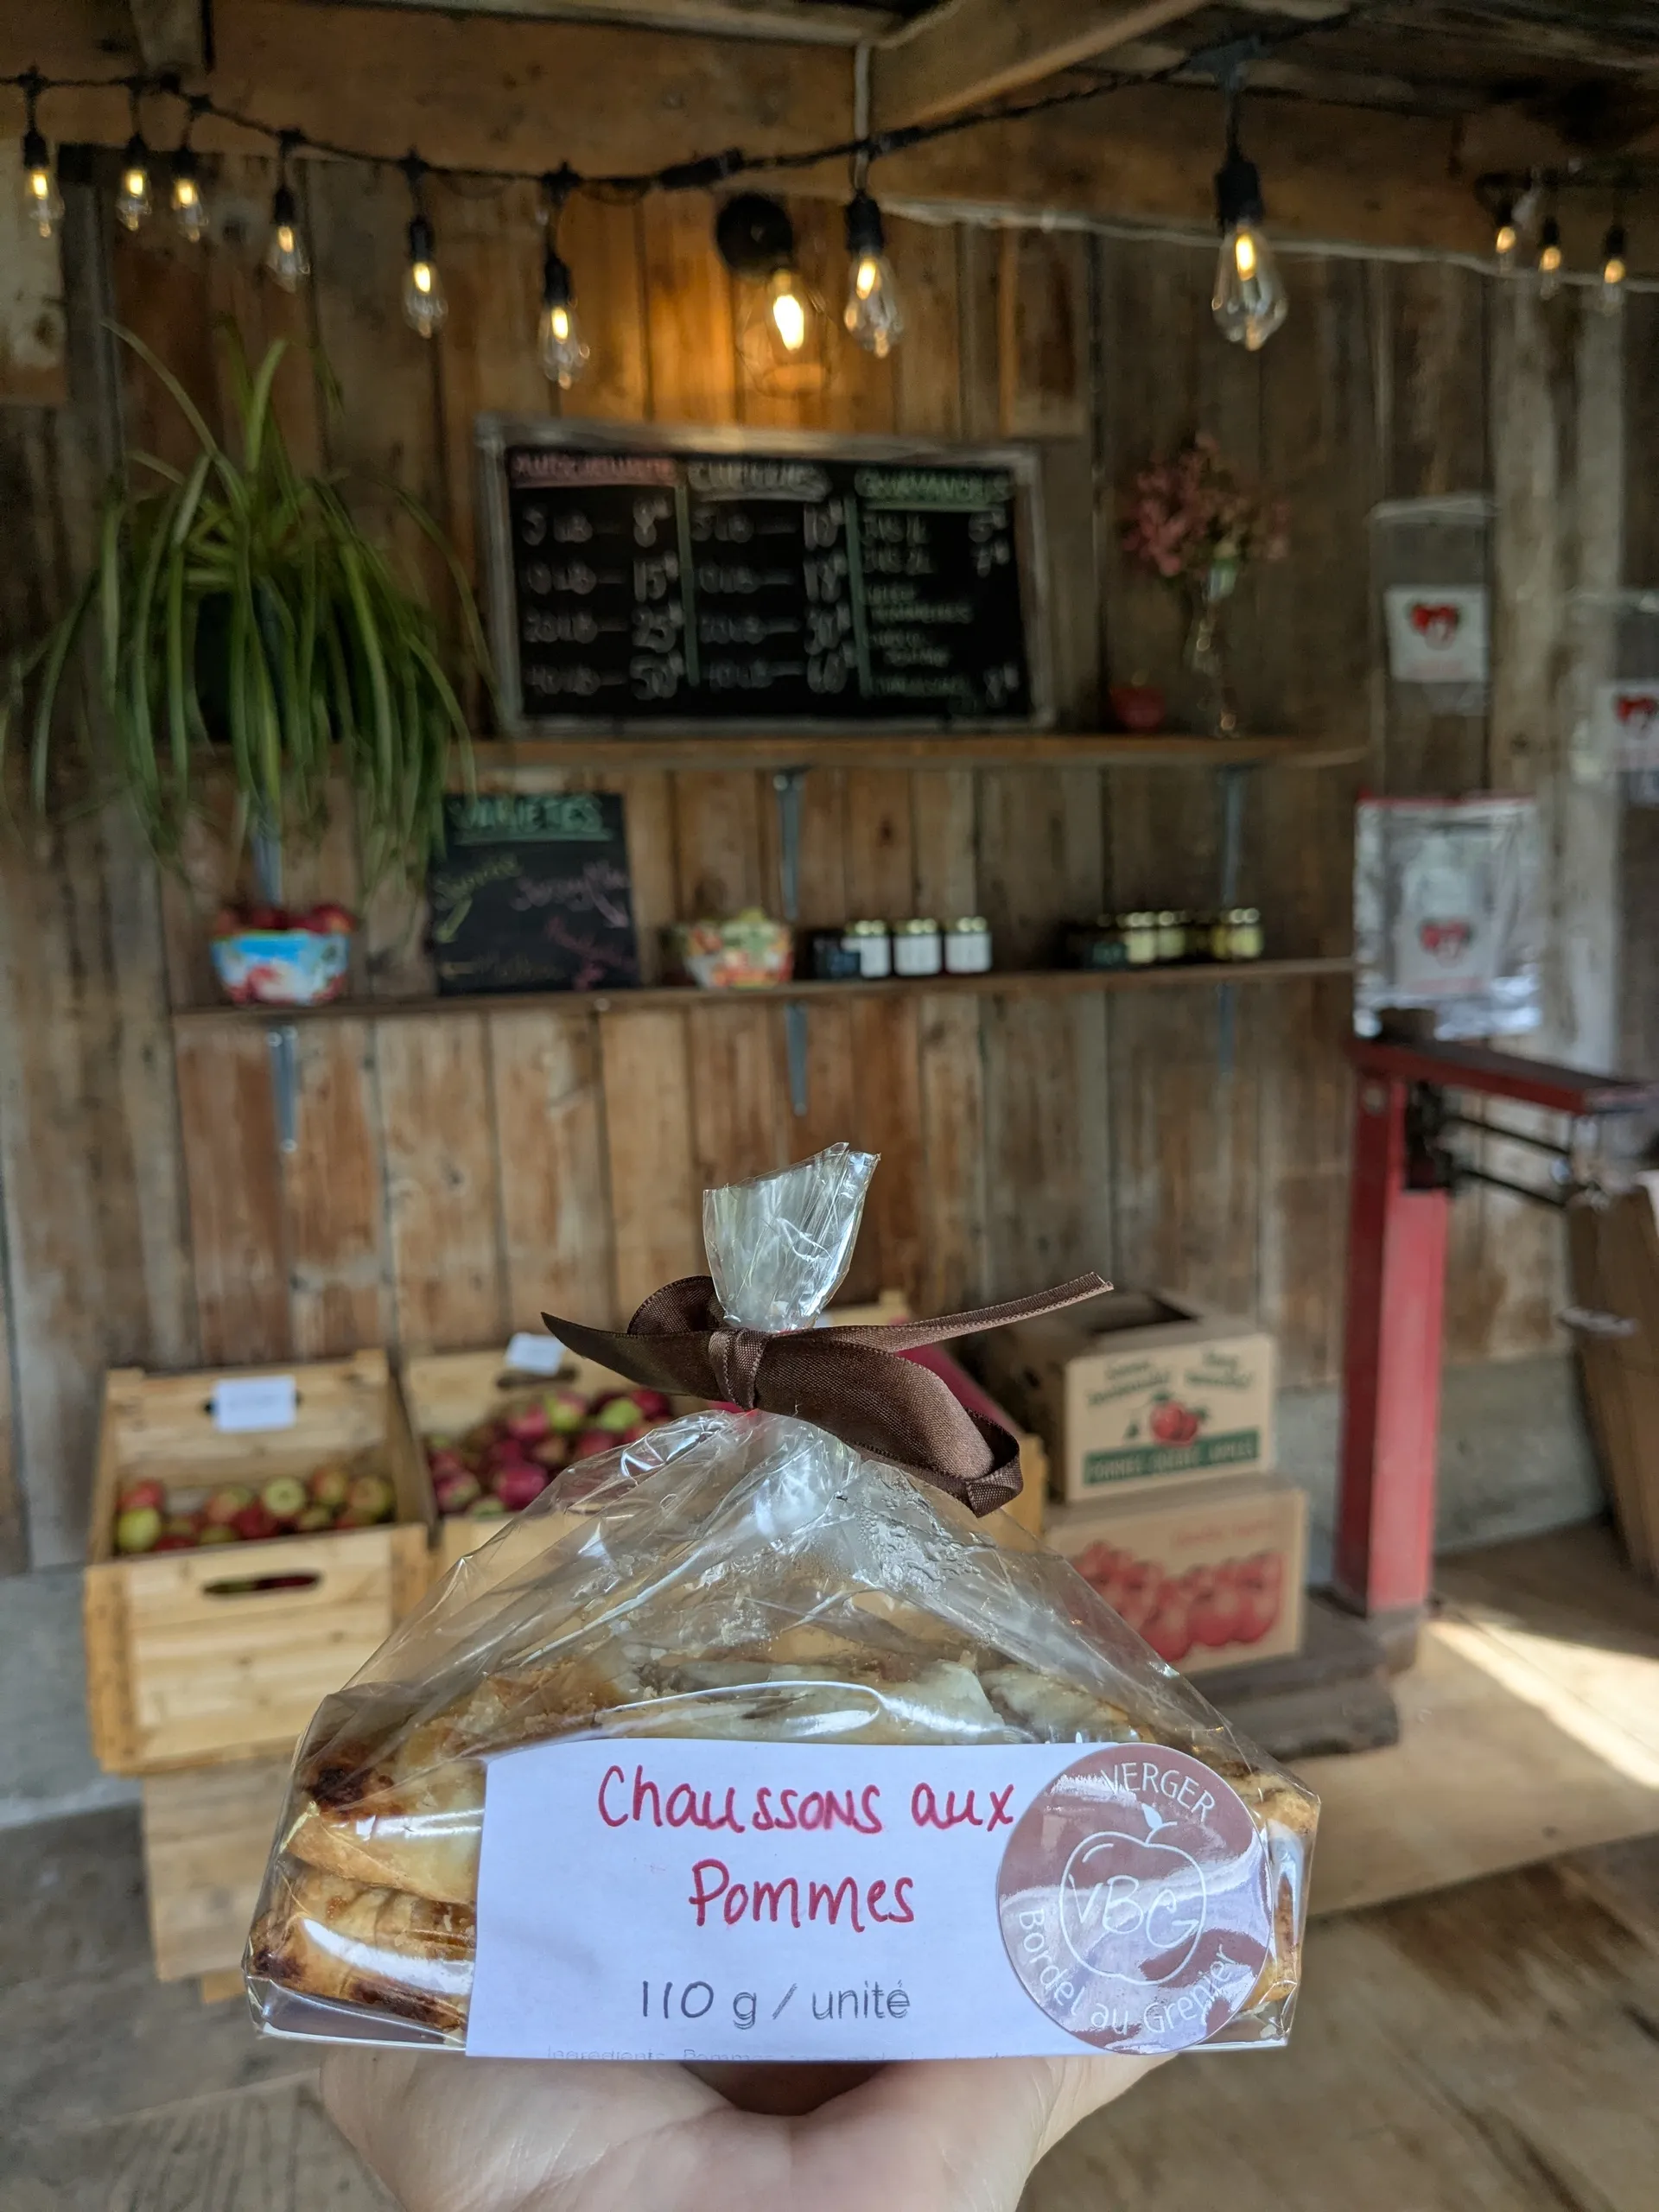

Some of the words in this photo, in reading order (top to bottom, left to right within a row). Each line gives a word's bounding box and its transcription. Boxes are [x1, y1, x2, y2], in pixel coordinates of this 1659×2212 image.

[597, 1764, 882, 1834] Chaussons
[911, 1782, 1015, 1832] aux
[1100, 1762, 1216, 1823] VERGER
[688, 1858, 915, 1933] Pommes
[1068, 1874, 1200, 1949] VBG
[642, 1980, 715, 2019] 110
[733, 1991, 758, 2031] g
[772, 1982, 798, 2021] /
[812, 1979, 912, 2020] unité
[1018, 1908, 1086, 2017] Bordel
[1090, 2002, 1129, 2036] au
[1143, 1943, 1238, 2034] Grenier
